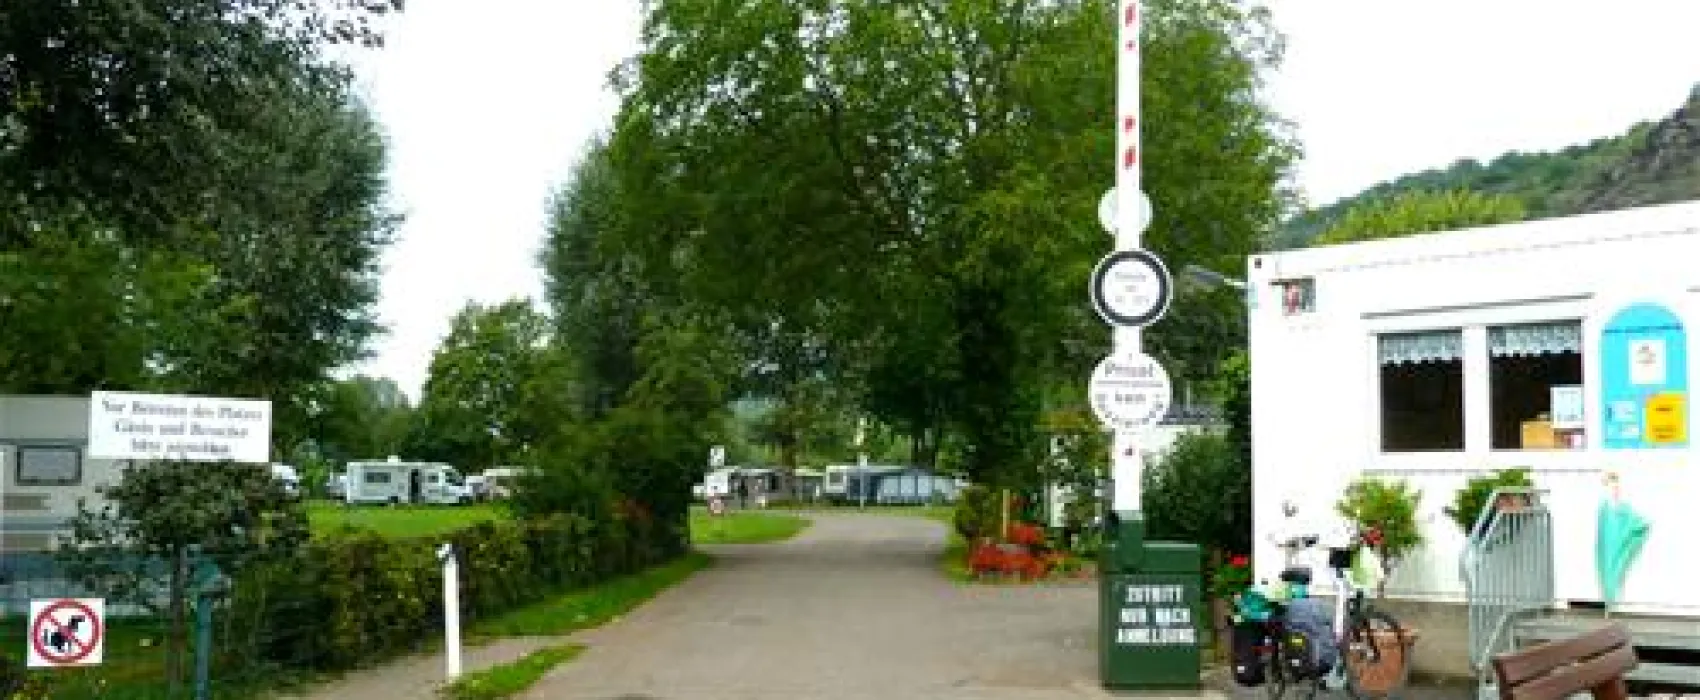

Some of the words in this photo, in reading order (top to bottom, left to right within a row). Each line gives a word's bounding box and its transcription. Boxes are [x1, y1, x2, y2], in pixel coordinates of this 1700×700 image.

[158, 421, 185, 435] und
[1120, 607, 1148, 623] NUR
[1154, 607, 1192, 624] NACH
[1116, 627, 1197, 644] ANMELDUNG
